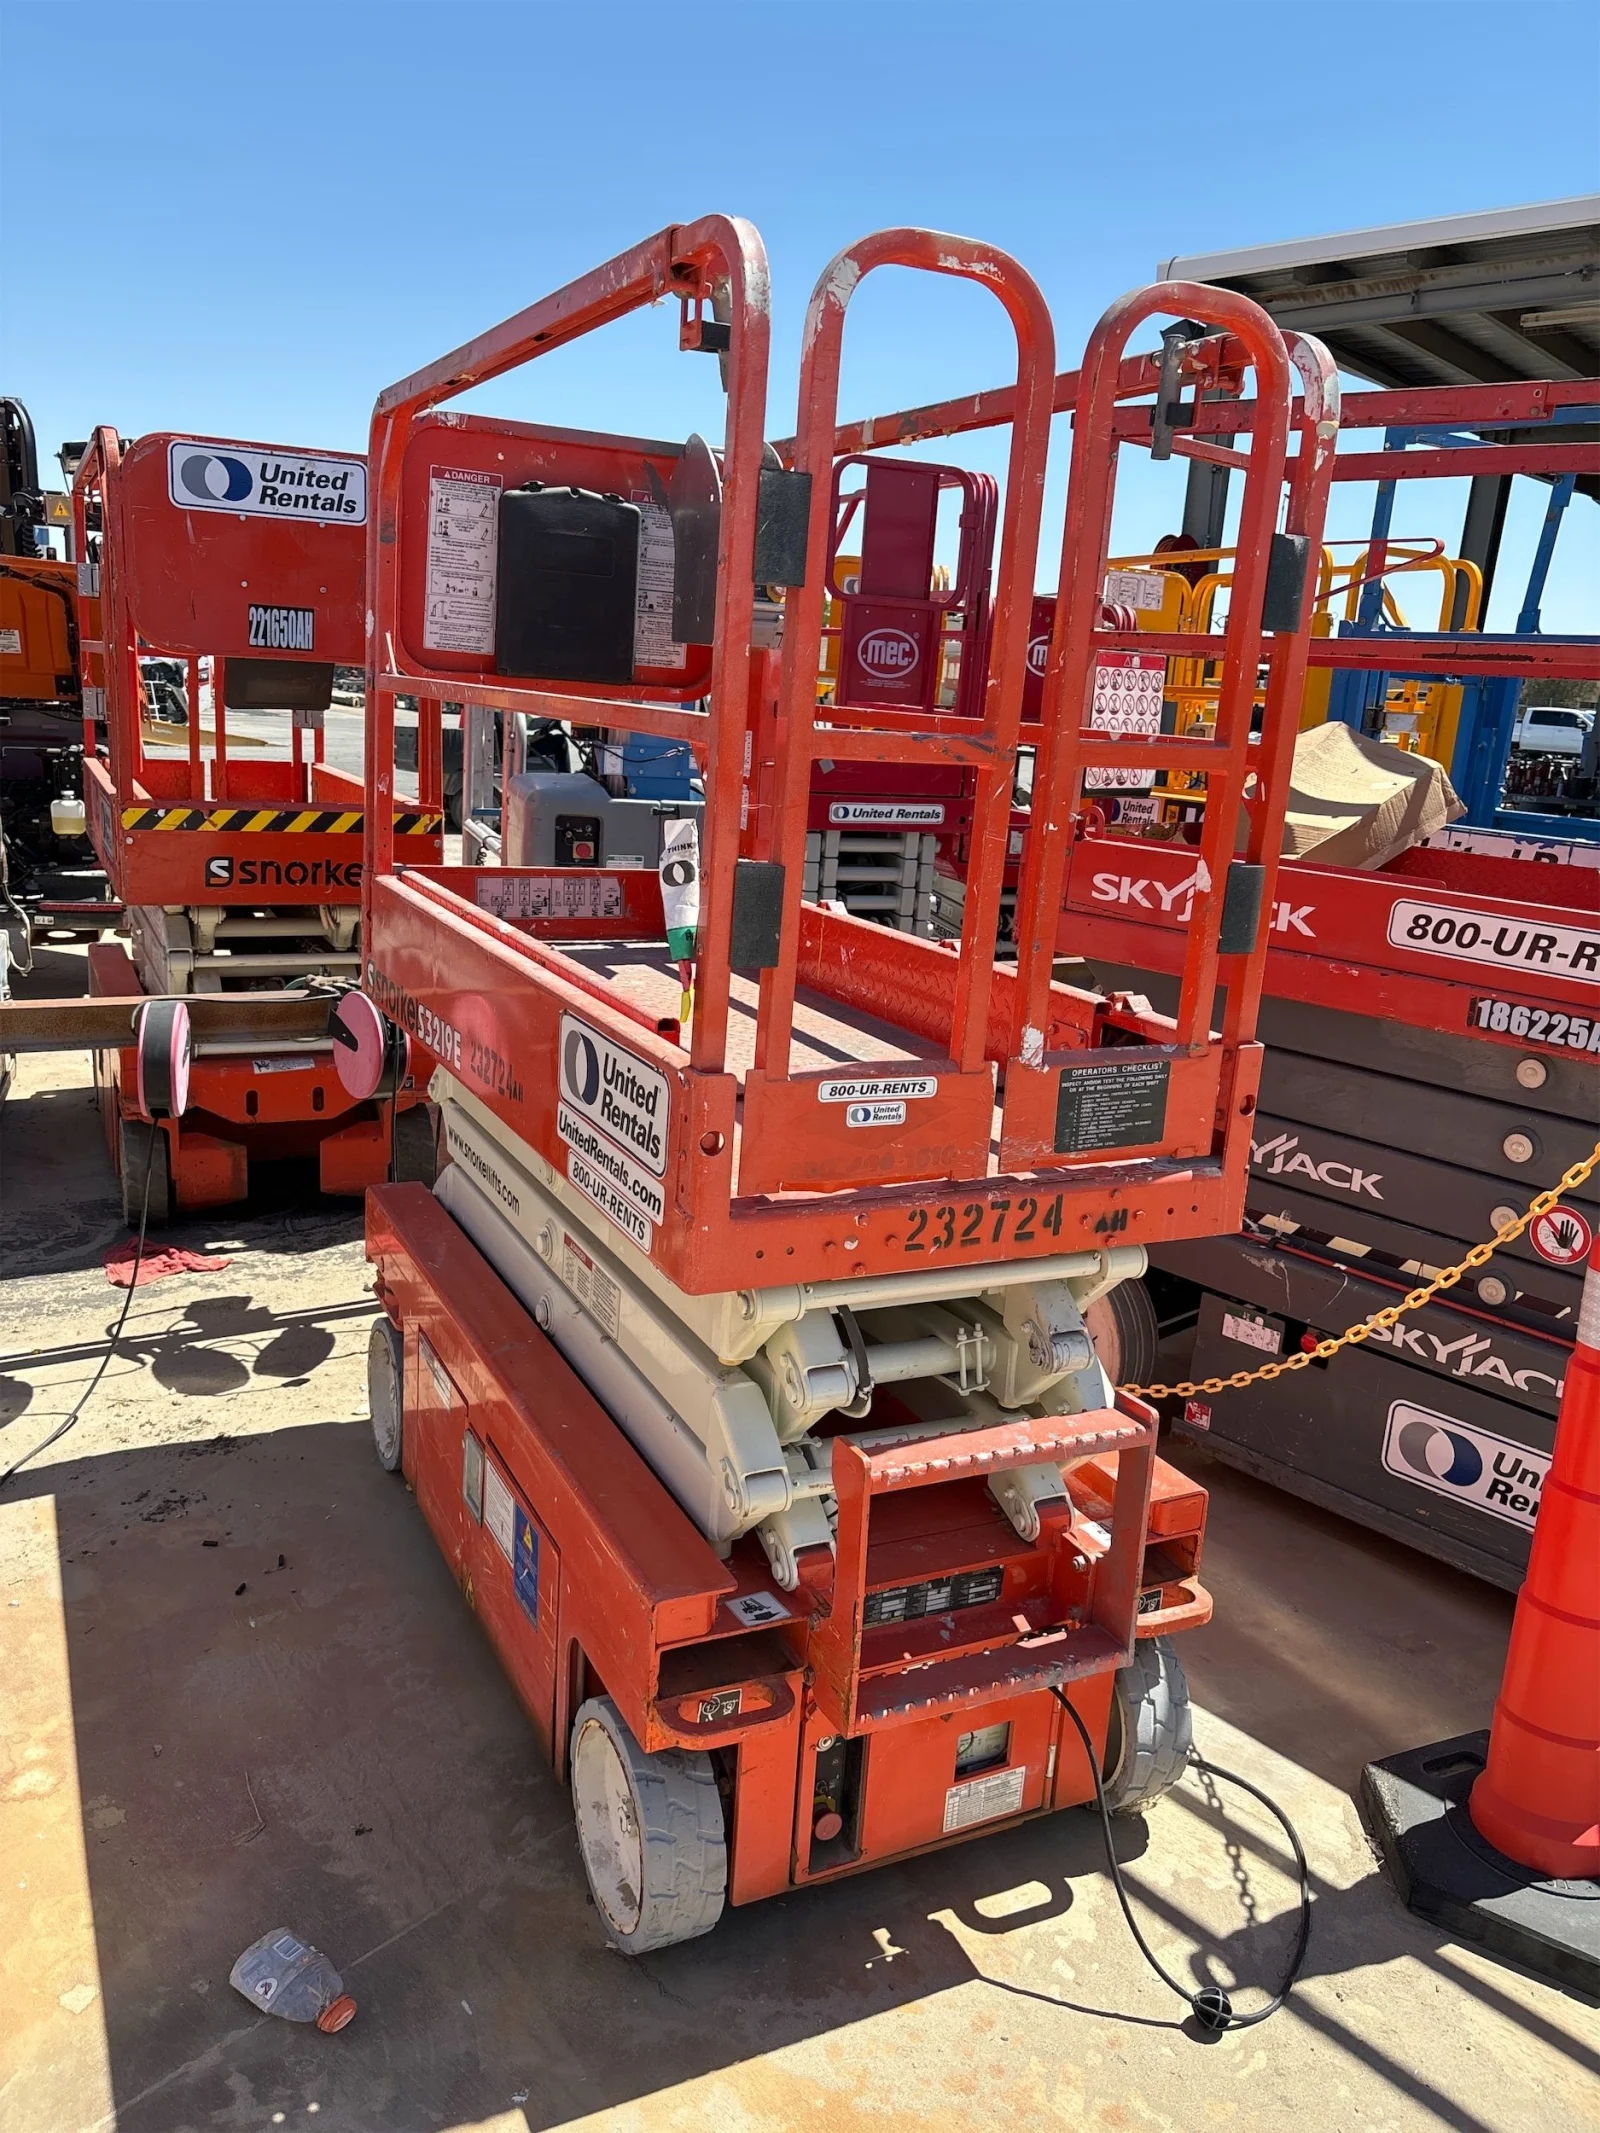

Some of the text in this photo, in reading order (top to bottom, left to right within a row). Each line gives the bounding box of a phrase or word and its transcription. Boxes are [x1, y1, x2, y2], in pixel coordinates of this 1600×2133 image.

[259, 462, 349, 491] United
[451, 471, 490, 484] DANGER
[258, 485, 357, 514] Rentals
[249, 606, 313, 650] 221650AH
[852, 808, 941, 820] United Rentals
[1123, 800, 1154, 814] United
[667, 842, 693, 854] THINK
[238, 858, 364, 888] snorke
[1091, 872, 1317, 938] SKYJK
[375, 969, 419, 1034] snorkel
[417, 1003, 462, 1073] S3219E
[602, 1052, 659, 1117] United
[1071, 1062, 1164, 1077] OPERATORS CHECKLIST
[829, 1082, 927, 1097] 800-UR-RENTS
[600, 1087, 660, 1160] Rentals
[872, 1112, 902, 1121] Rentals
[873, 1105, 901, 1114] United
[448, 1123, 520, 1217] www.snorkellifts.com
[558, 1110, 662, 1216] UnitedRentals.com
[1250, 1133, 1385, 1200] YJACK
[572, 1160, 646, 1241] 800-UR-RENTS
[904, 1193, 1064, 1252] 232724
